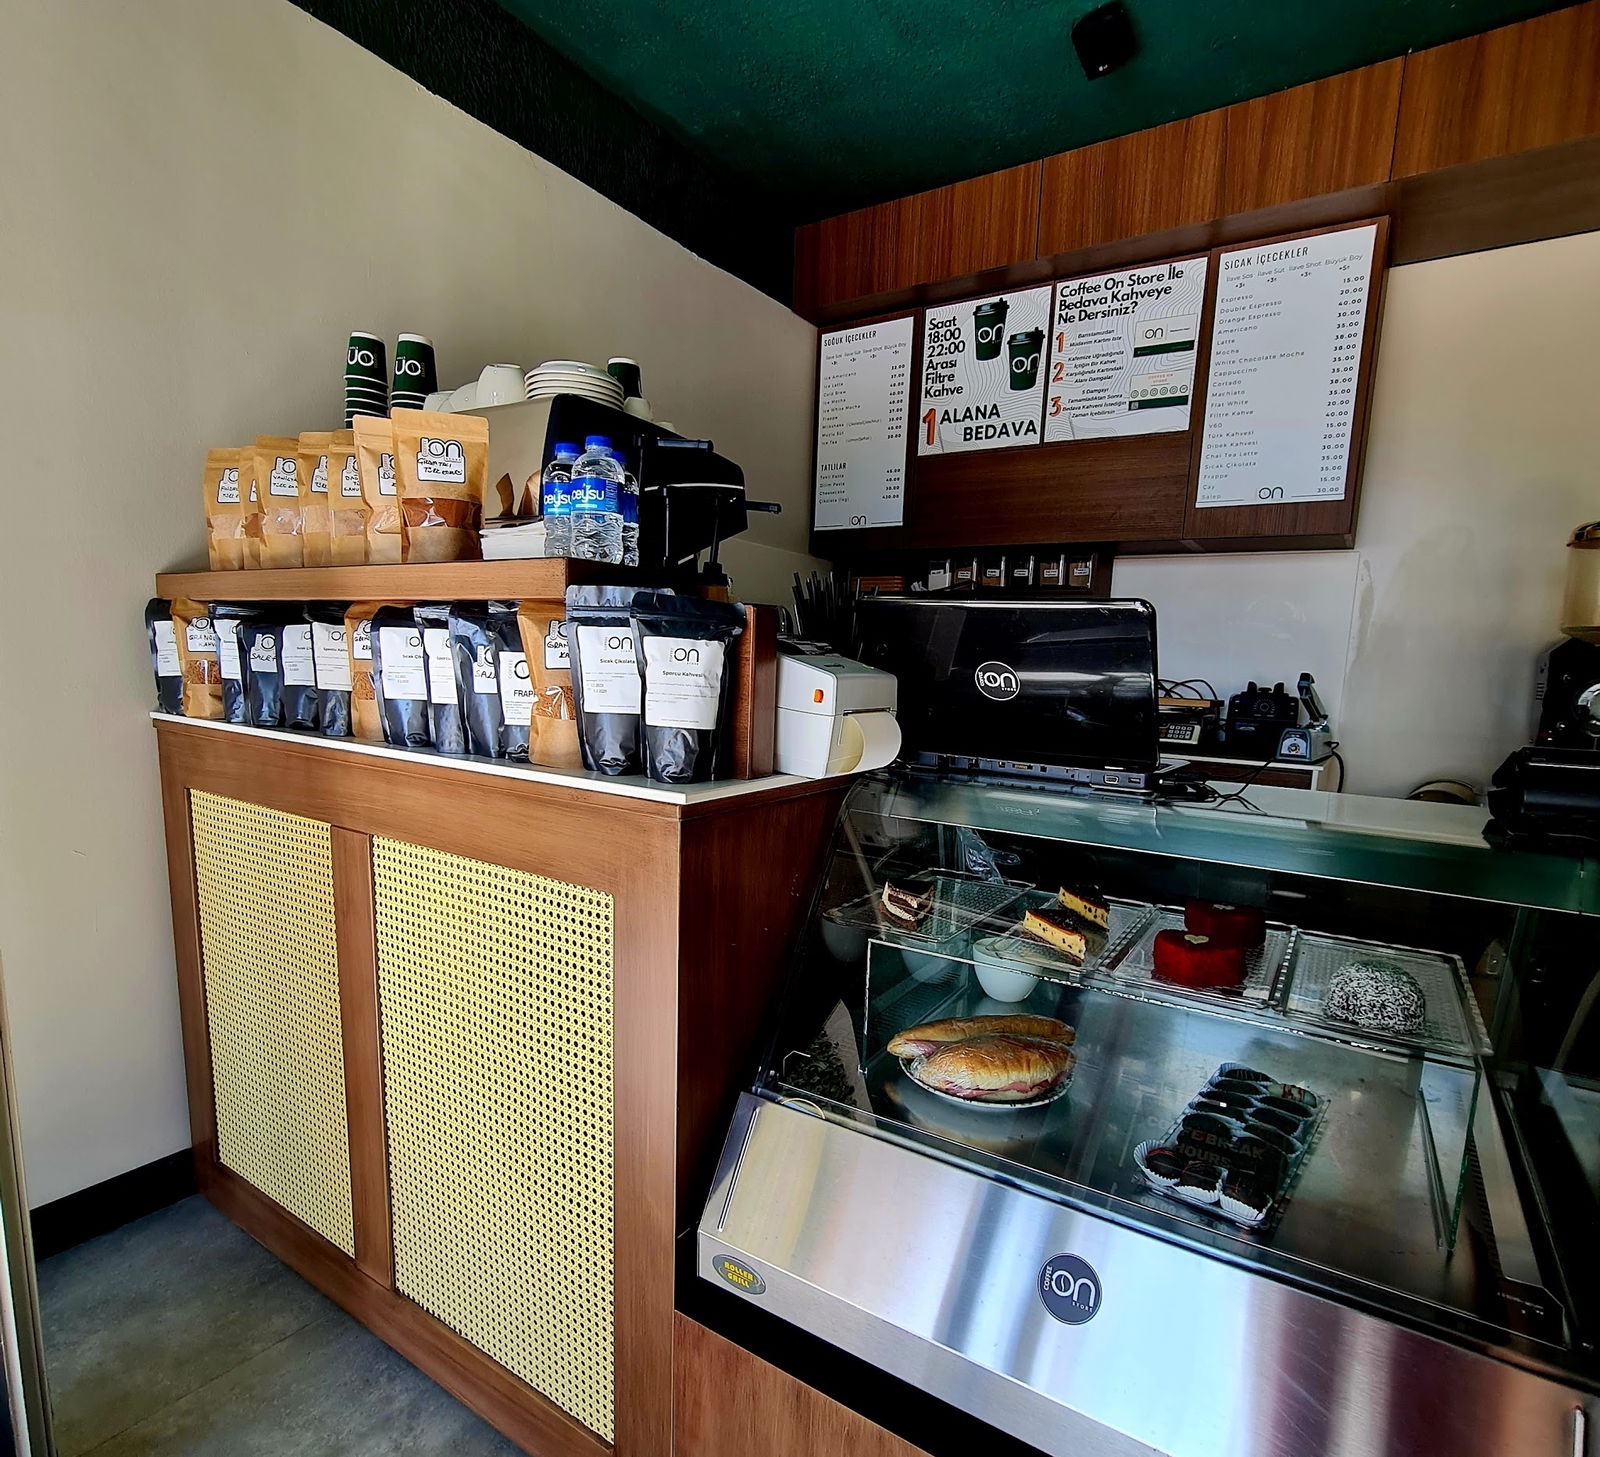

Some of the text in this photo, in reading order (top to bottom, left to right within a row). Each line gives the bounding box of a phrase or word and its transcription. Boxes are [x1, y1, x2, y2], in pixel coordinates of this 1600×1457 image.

[1225, 247, 1308, 270] SICAK İÇECEKLER
[1060, 264, 1184, 298] Coffee On Store İle
[1059, 285, 1172, 312] Bedava Kahveye
[1221, 294, 1253, 304] Espresso
[1058, 301, 1138, 325] Ne Dersiniz?
[1220, 300, 1282, 314] Double Espresso
[928, 316, 957, 330] Saat
[1218, 311, 1281, 325] Orange Espresso
[928, 328, 961, 344] 18:00
[1144, 327, 1164, 339] on
[1217, 325, 1258, 335] Americano
[927, 340, 966, 358] 22:00
[1056, 332, 1065, 353] 1
[1238, 354, 1277, 364] Chocolate
[1279, 350, 1305, 358] Mocha
[926, 359, 957, 372] Arası
[1053, 362, 1065, 383] 2
[1213, 367, 1258, 377] Cappuccino
[926, 371, 955, 385] Filtre
[1212, 380, 1242, 388] Cortado
[924, 384, 963, 399] Kahve
[1211, 390, 1246, 398] Machiato
[1050, 396, 1062, 417] 3
[1227, 399, 1249, 407] White
[940, 403, 1001, 424] ALANA
[1231, 409, 1254, 417] Kahve
[923, 408, 936, 445] 1
[963, 419, 1037, 441] BEDAVA
[1226, 430, 1254, 438] Kahvesi
[428, 440, 461, 458] on
[821, 462, 847, 472] TATLILAR
[1258, 486, 1284, 499] on
[608, 636, 633, 650] on
[673, 648, 699, 663] on
[984, 672, 1016, 689] on
[724, 1261, 753, 1281] ROLLER
[1043, 1265, 1053, 1291] COFFEE
[727, 1272, 750, 1288] GRILL
[1051, 1270, 1096, 1307] on
[1072, 1301, 1093, 1313] STORE
